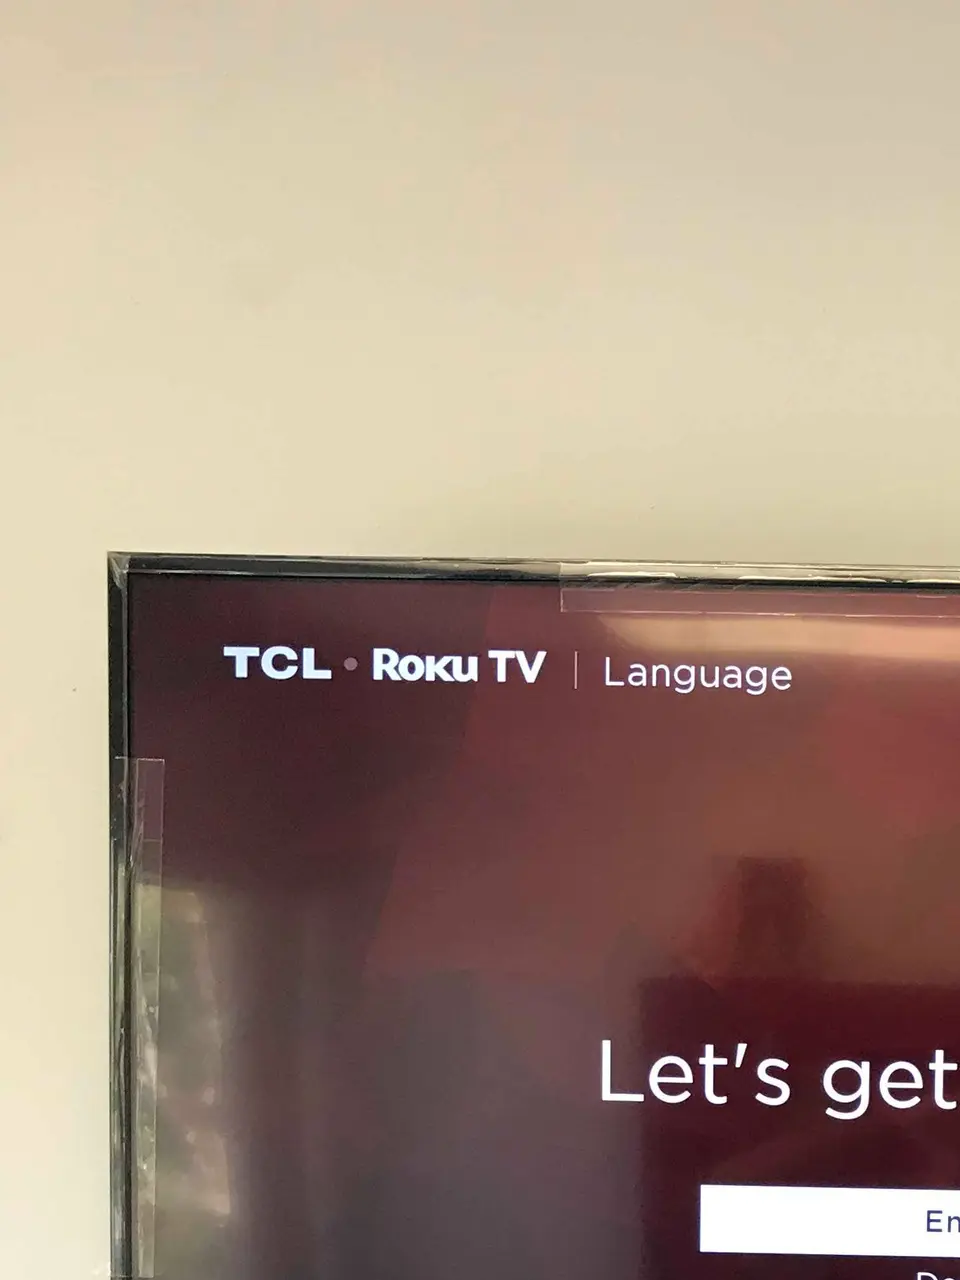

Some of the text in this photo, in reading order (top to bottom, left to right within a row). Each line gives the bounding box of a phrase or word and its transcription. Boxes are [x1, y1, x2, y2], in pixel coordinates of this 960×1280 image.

[223, 646, 332, 680] TCL
[487, 649, 548, 684] TV
[604, 656, 793, 695] Language
[601, 1039, 791, 1106] Let's
[822, 1049, 958, 1120] get
